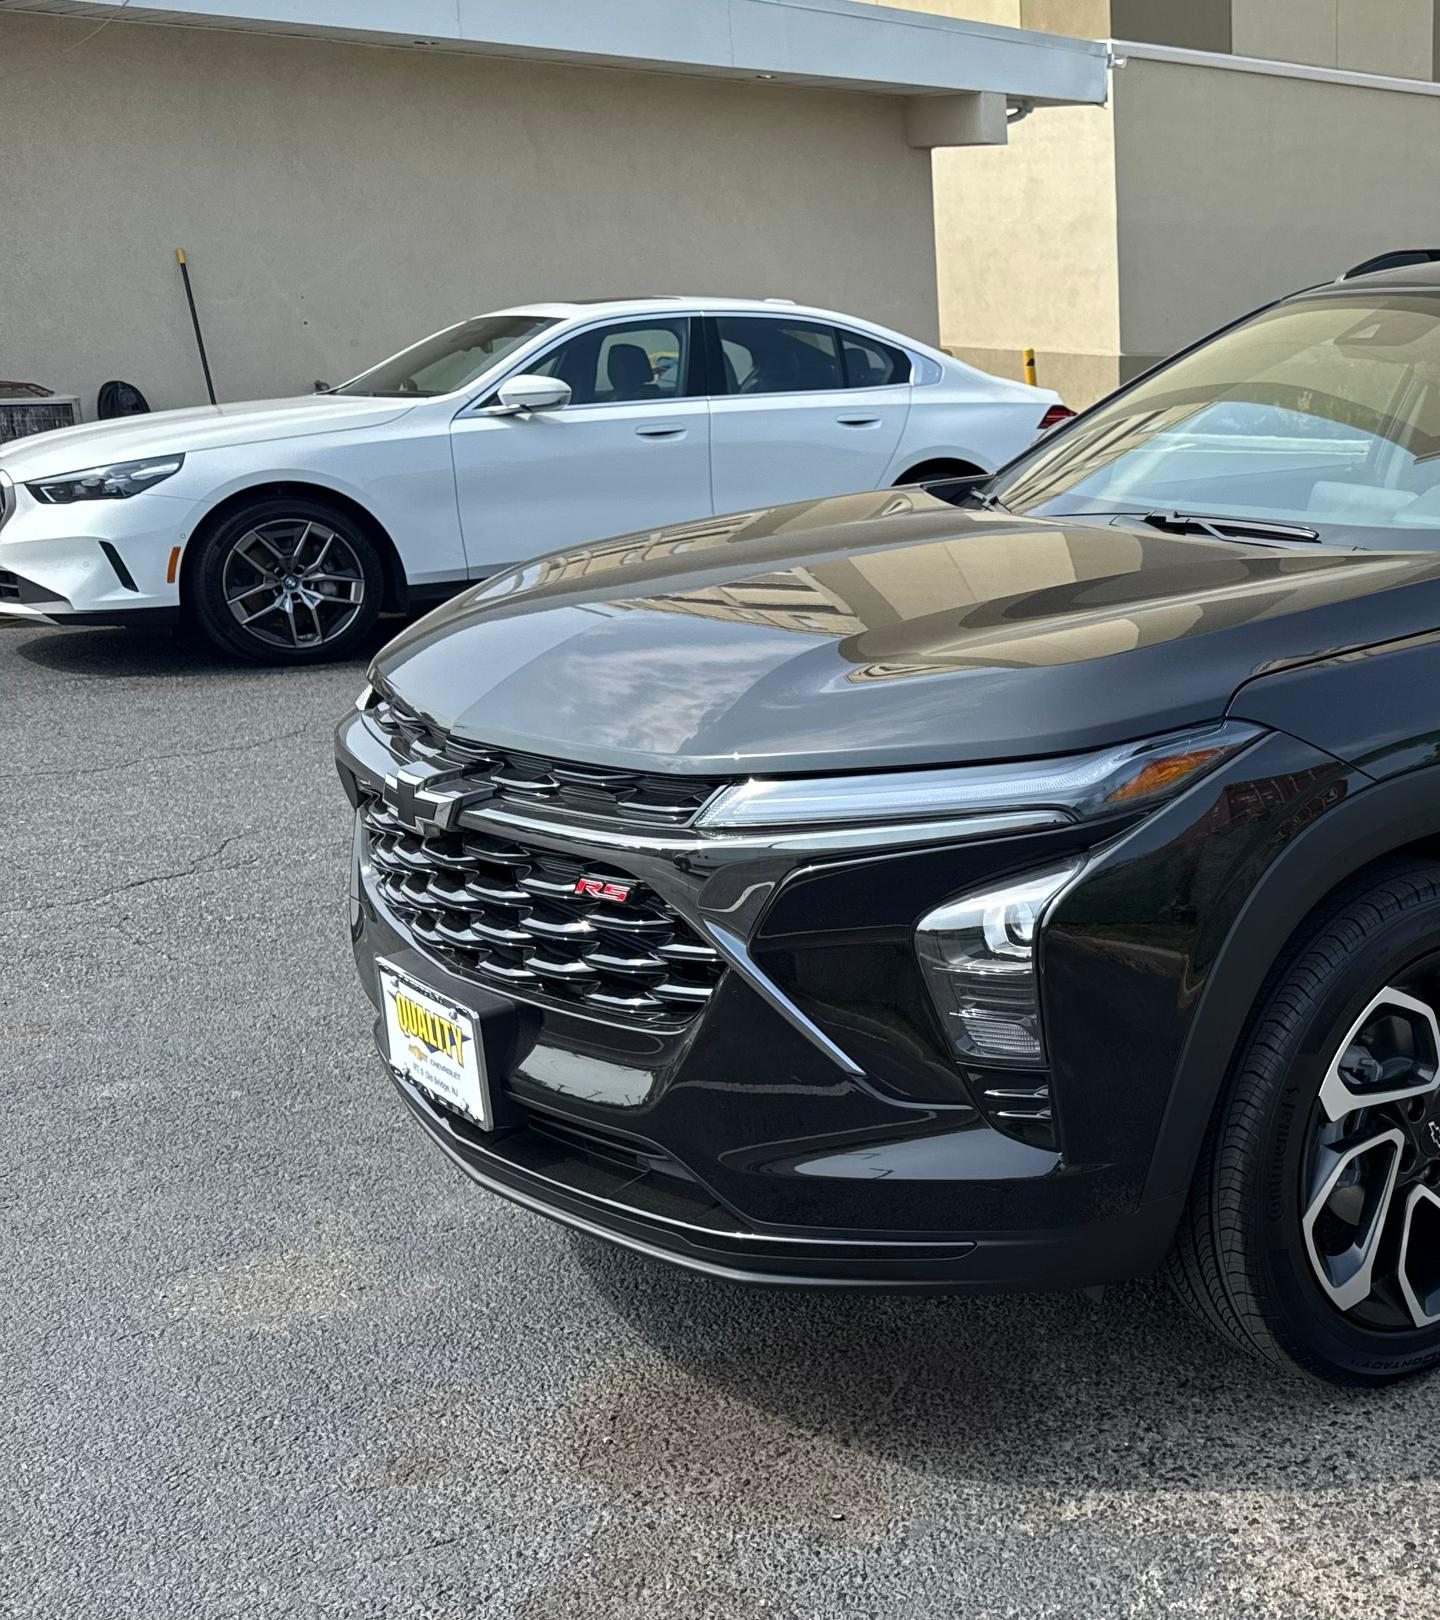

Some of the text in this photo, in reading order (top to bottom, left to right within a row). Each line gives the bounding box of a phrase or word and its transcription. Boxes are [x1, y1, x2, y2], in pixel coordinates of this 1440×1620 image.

[575, 878, 631, 902] RS
[395, 990, 464, 1069] QUALITY
[430, 1059, 461, 1081] CHEVROLET
